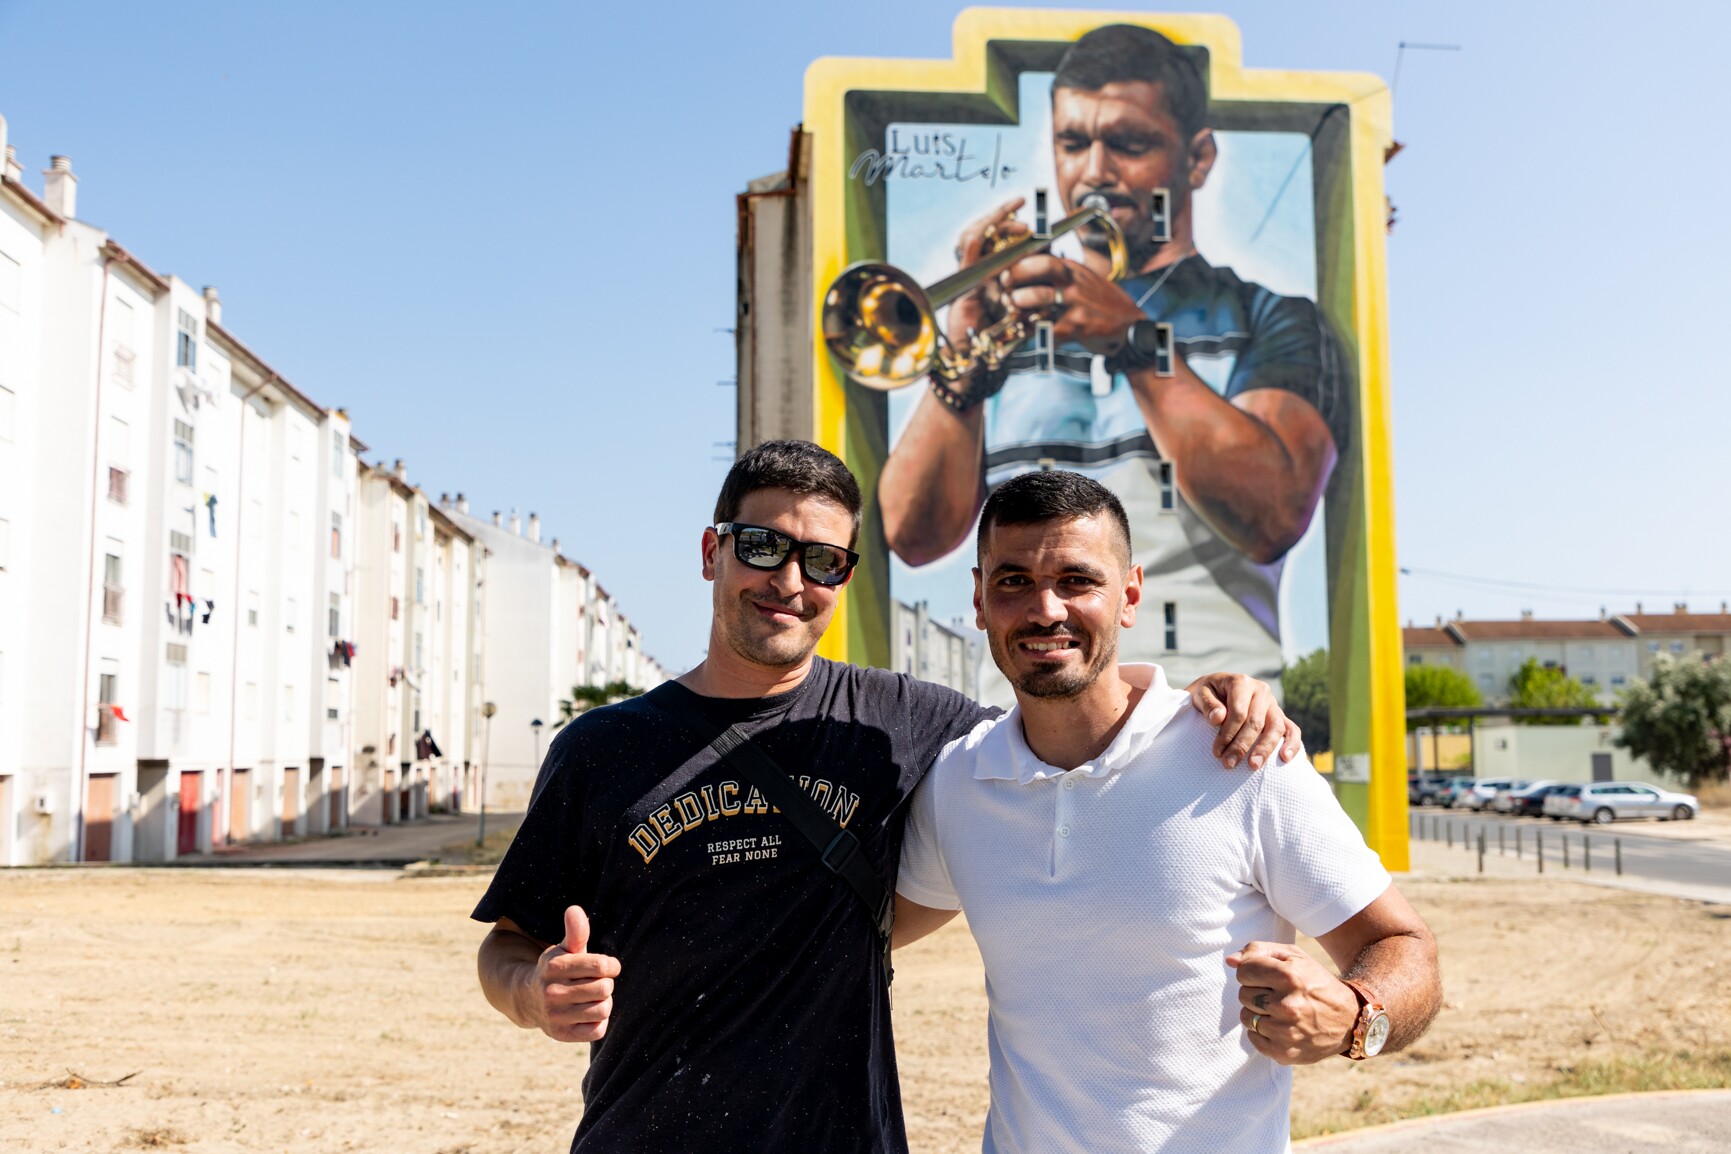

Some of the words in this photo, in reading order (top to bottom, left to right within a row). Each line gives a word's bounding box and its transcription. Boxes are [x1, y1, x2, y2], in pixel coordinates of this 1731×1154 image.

[628, 775, 860, 864] DEDICAON
[707, 838, 757, 853] RESPECT
[761, 834, 782, 847] ALL
[712, 853, 740, 866] FEAR
[745, 848, 778, 861] NONE
